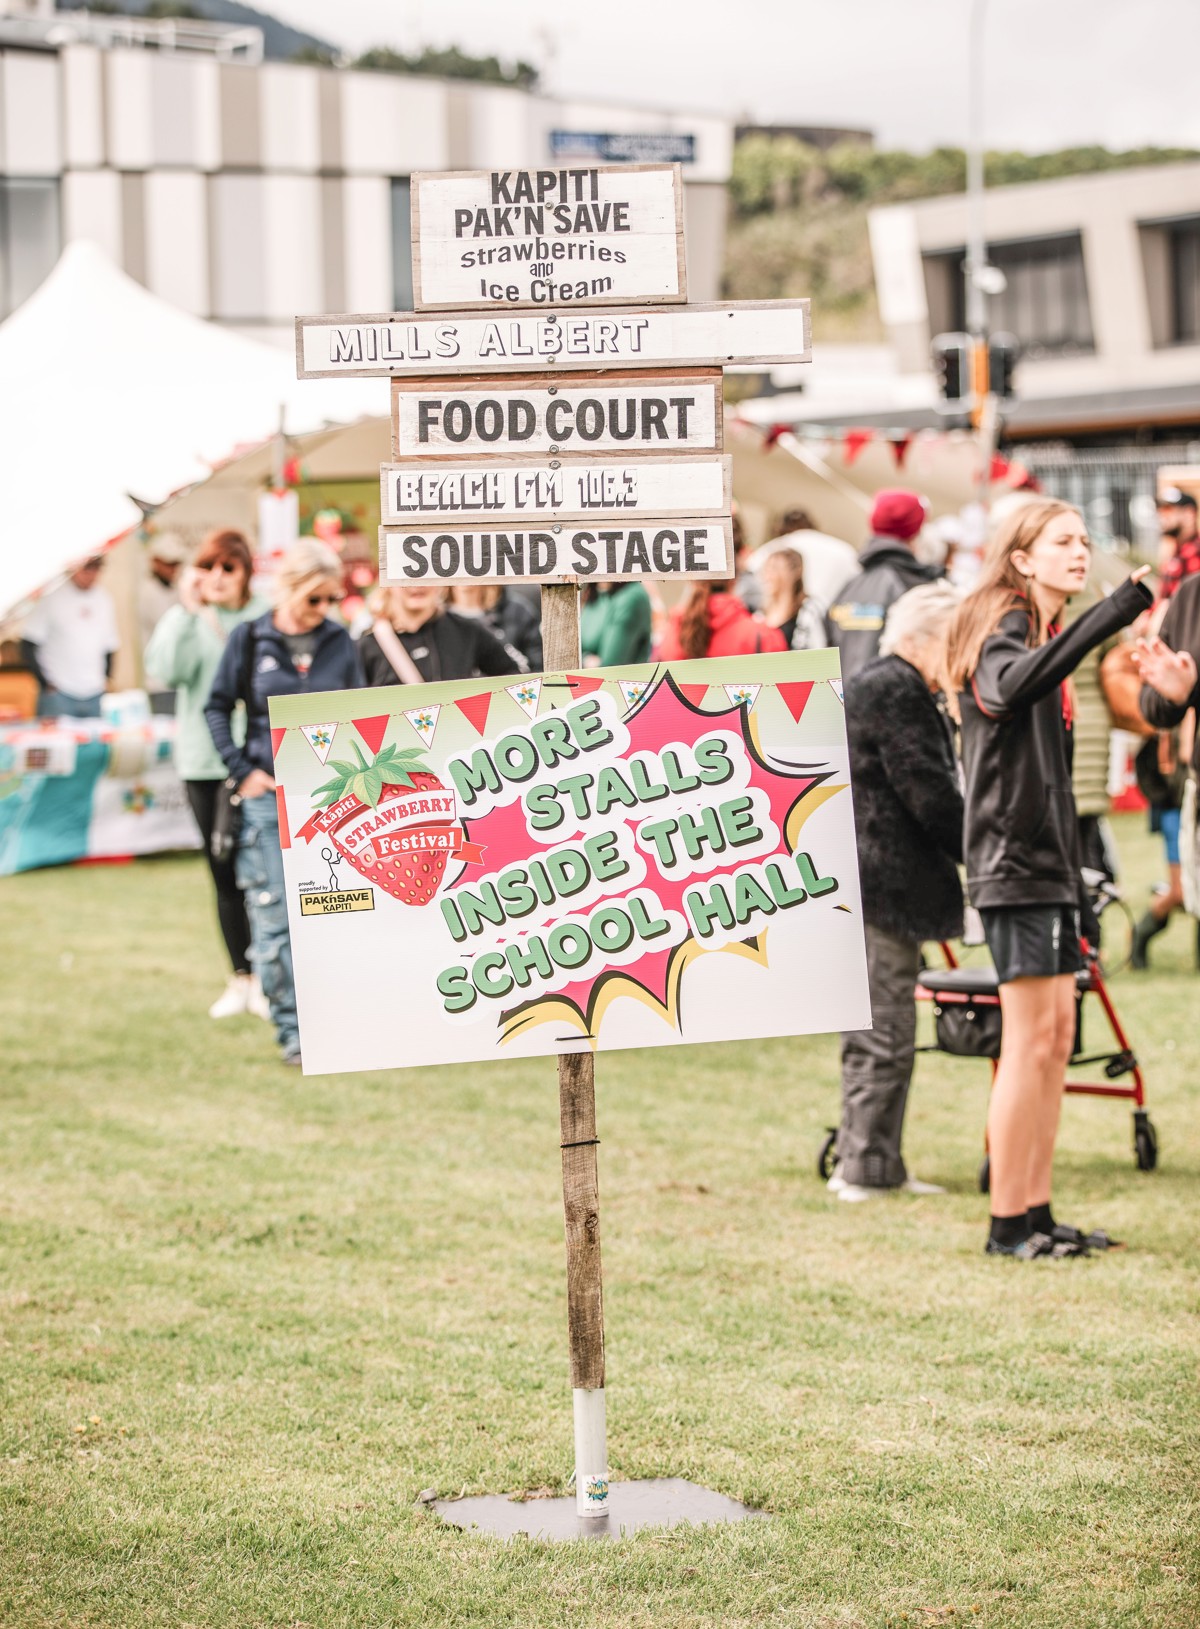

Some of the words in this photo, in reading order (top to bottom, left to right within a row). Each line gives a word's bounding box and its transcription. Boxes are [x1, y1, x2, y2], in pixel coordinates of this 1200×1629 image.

[491, 169, 599, 205] KAPITI
[455, 206, 545, 239] PAK'N
[554, 202, 631, 234] SAVE
[481, 279, 520, 301] Ice
[531, 277, 612, 303] Cream
[530, 261, 554, 278] and
[330, 325, 460, 362] MILLS
[479, 319, 649, 357] ALBERT
[418, 399, 537, 443] FOOD
[546, 397, 695, 441] COURT
[397, 472, 506, 511] BEACH
[515, 470, 563, 508] FM
[578, 469, 638, 508] 106.3
[402, 532, 558, 578] SOUND
[571, 529, 709, 575] STAGE
[445, 699, 615, 806] MORE
[526, 739, 735, 832] STALLS
[344, 797, 454, 849] STRAWBERRY
[378, 831, 456, 855] Festival
[440, 831, 630, 943] INSIDE
[641, 796, 763, 867] THE
[323, 902, 352, 912] KAPITI
[437, 898, 672, 1014] SCHOOL
[687, 852, 839, 938] HALL
